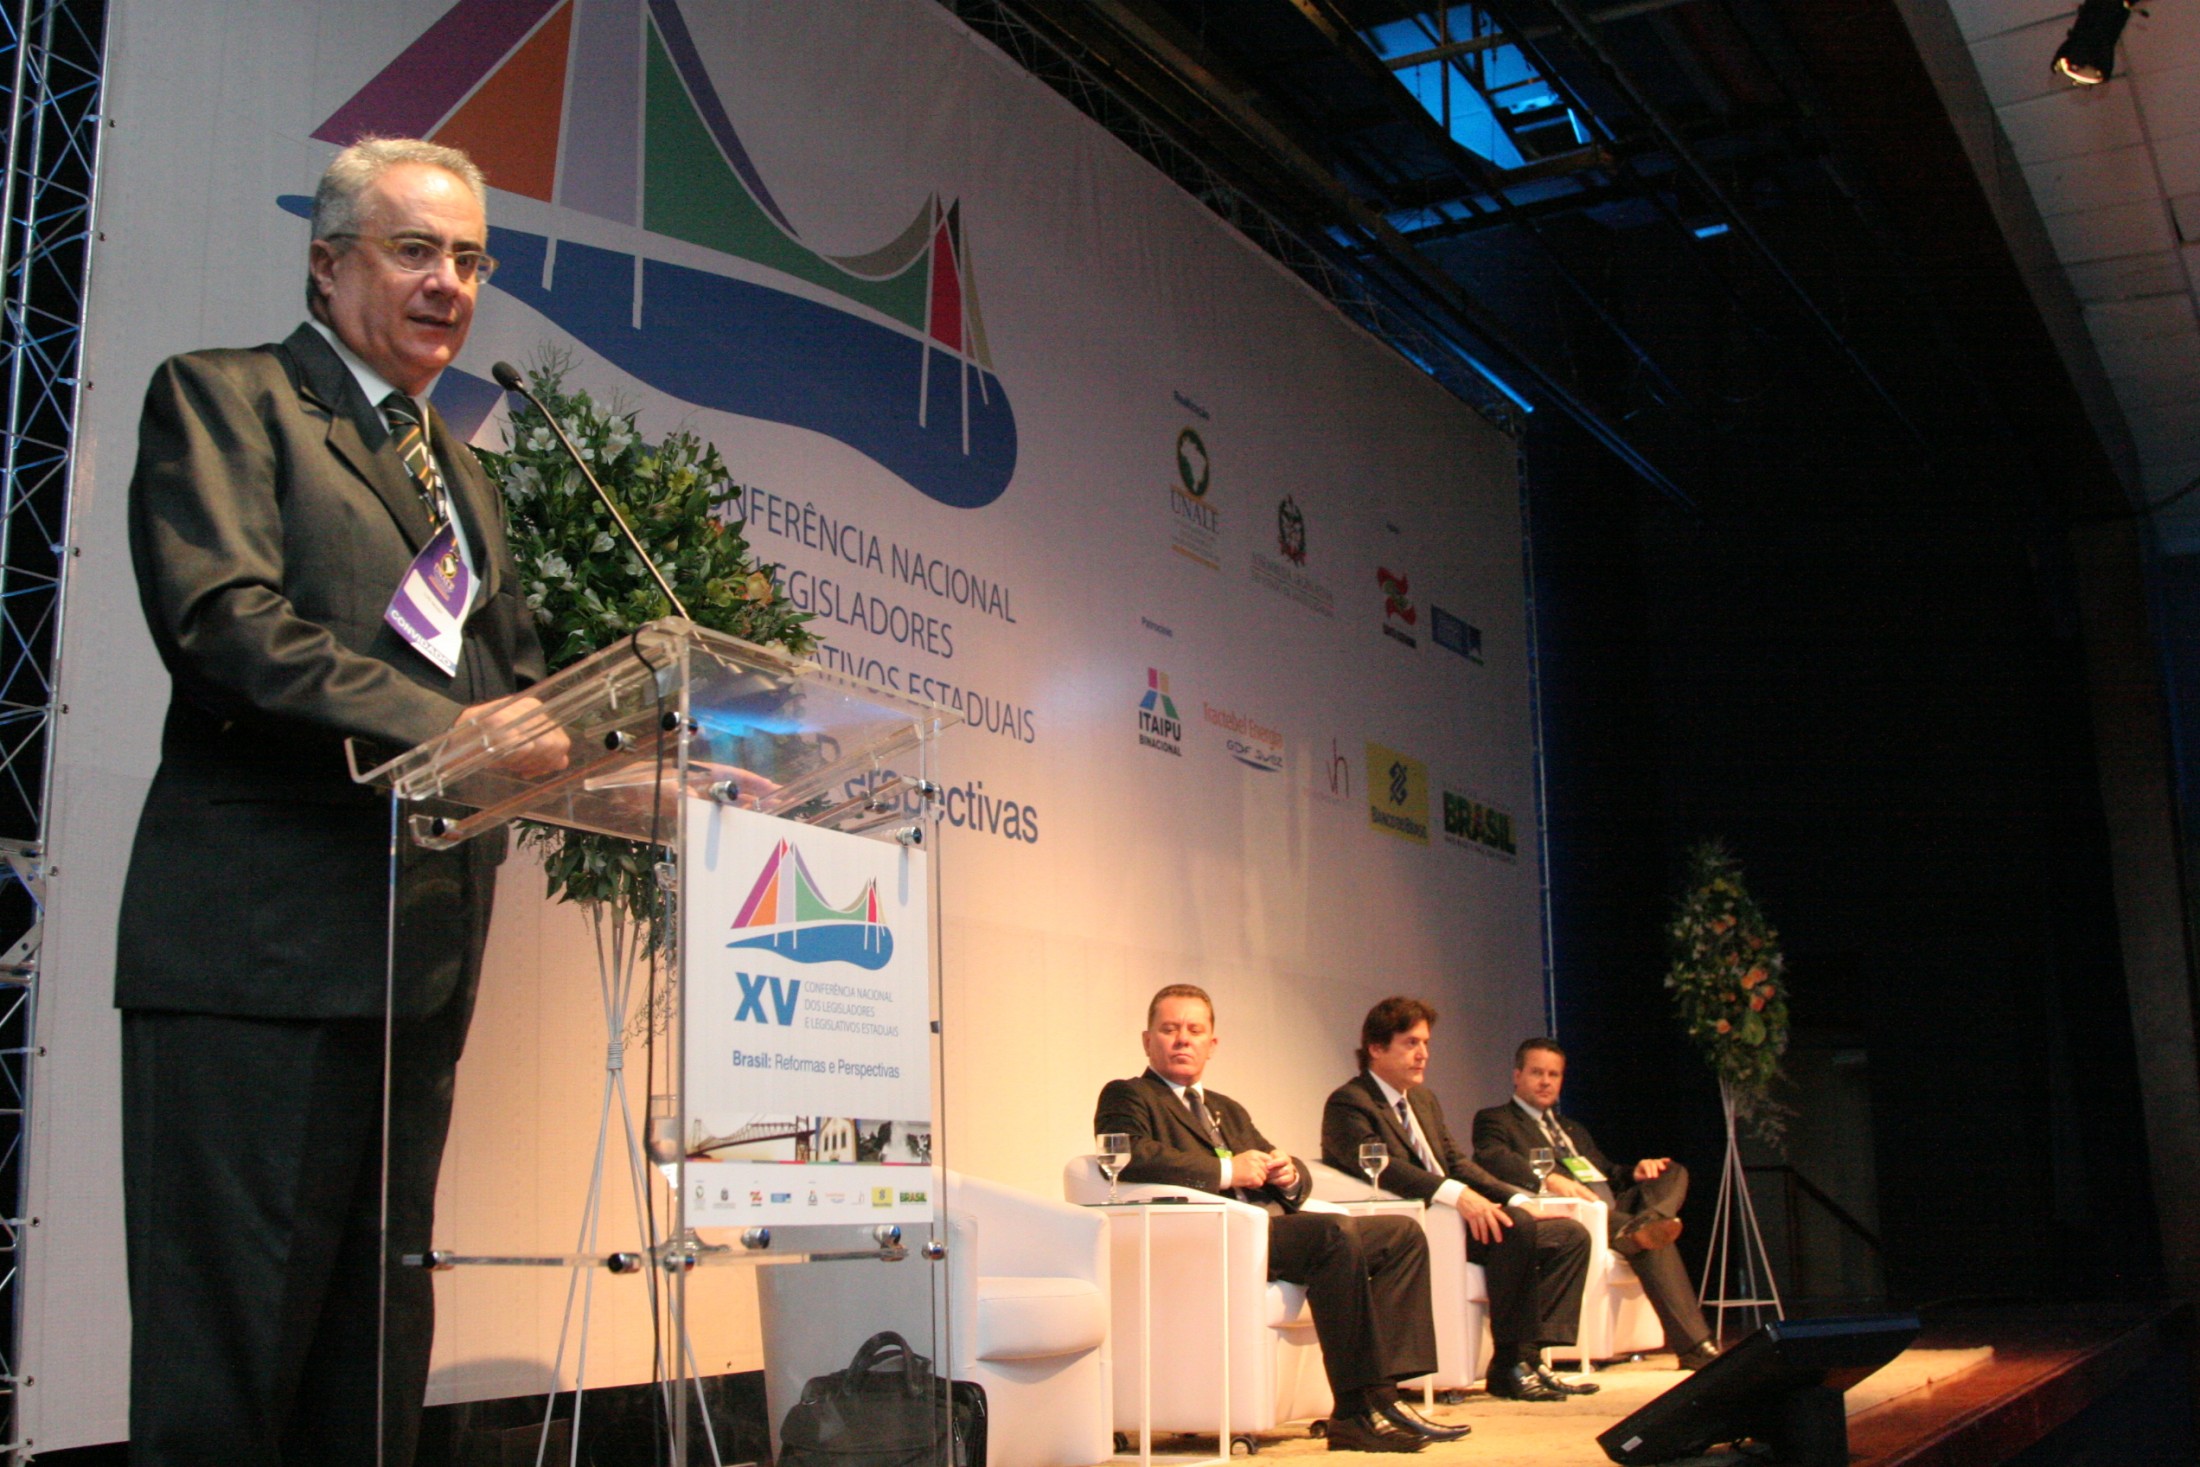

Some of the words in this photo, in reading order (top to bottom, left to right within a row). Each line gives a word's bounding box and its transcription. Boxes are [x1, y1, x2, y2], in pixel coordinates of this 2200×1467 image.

[710, 480, 883, 574] ONFERÊNCIA
[892, 543, 1017, 624] NACIONAL
[756, 555, 953, 659] EGISLADORES
[1138, 711, 1182, 742] ITAIPU
[1138, 734, 1182, 757] BINACIONAL
[1443, 790, 1517, 856] BRASIL
[734, 971, 802, 1027] XV
[804, 980, 856, 998] CONFERÊNCIA
[856, 988, 894, 1003] NACIONAL
[804, 998, 822, 1012] DOS
[822, 1000, 875, 1018] LEGISLADORES
[804, 1017, 810, 1029] E
[810, 1018, 861, 1034] LEGISLATIVOS
[861, 1024, 899, 1038] ESTADUAIS
[732, 1050, 772, 1069] Brasil:
[774, 1053, 826, 1074] Reformas
[828, 1062, 836, 1074] e
[837, 1058, 900, 1080] Perspectivas
